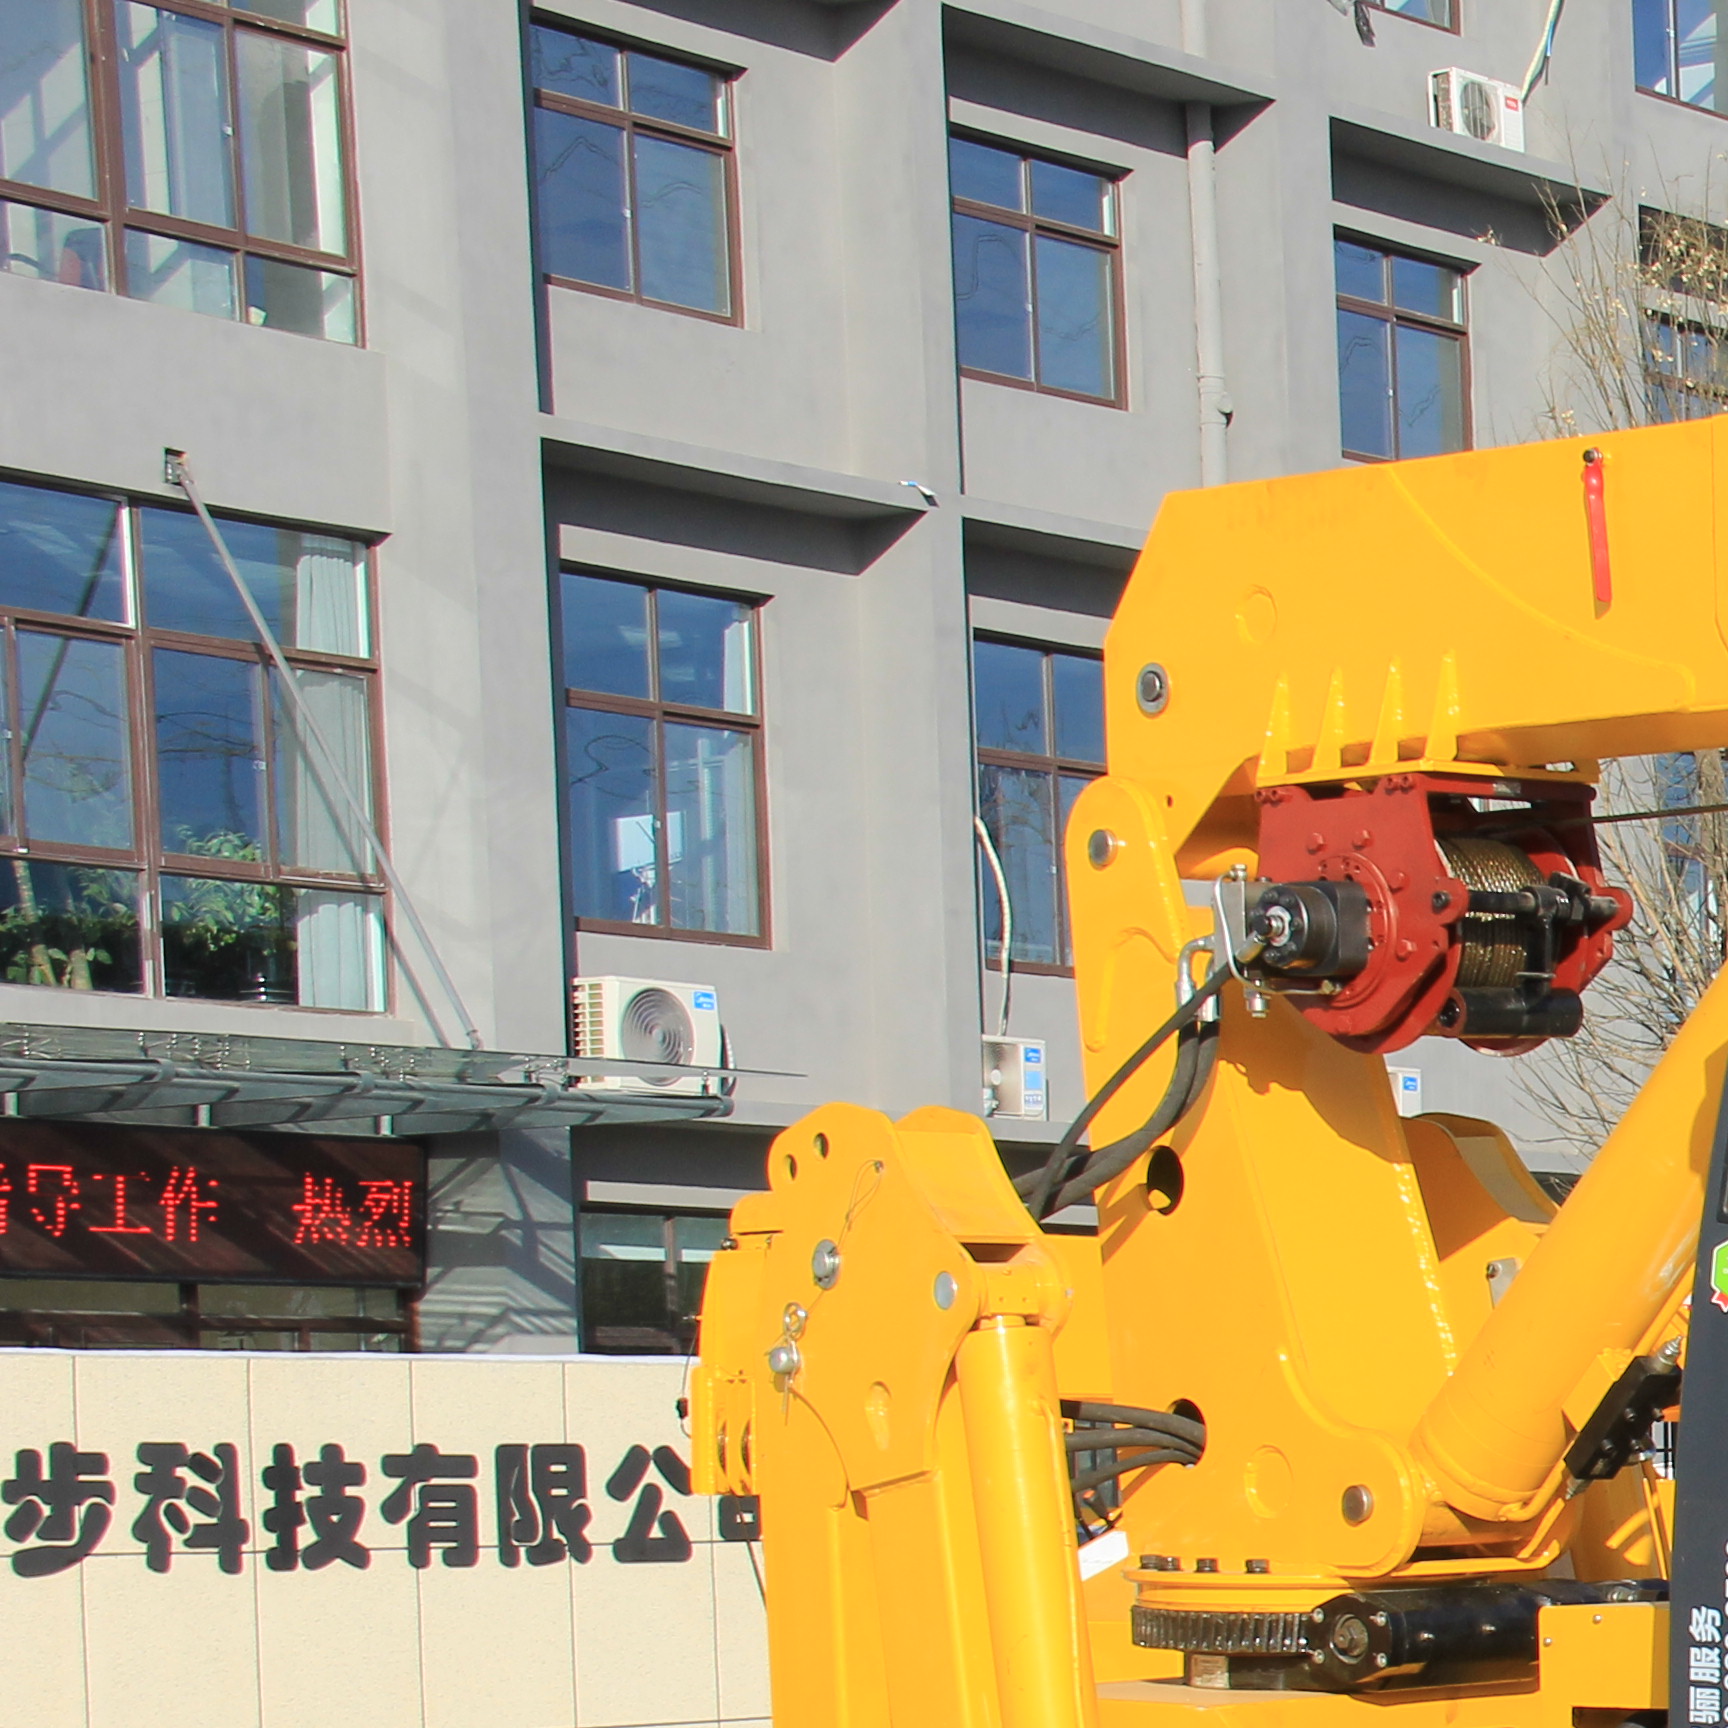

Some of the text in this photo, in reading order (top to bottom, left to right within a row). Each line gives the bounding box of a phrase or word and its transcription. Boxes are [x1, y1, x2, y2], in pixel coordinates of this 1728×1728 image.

[0, 1162, 413, 1248] 导工作 热烈
